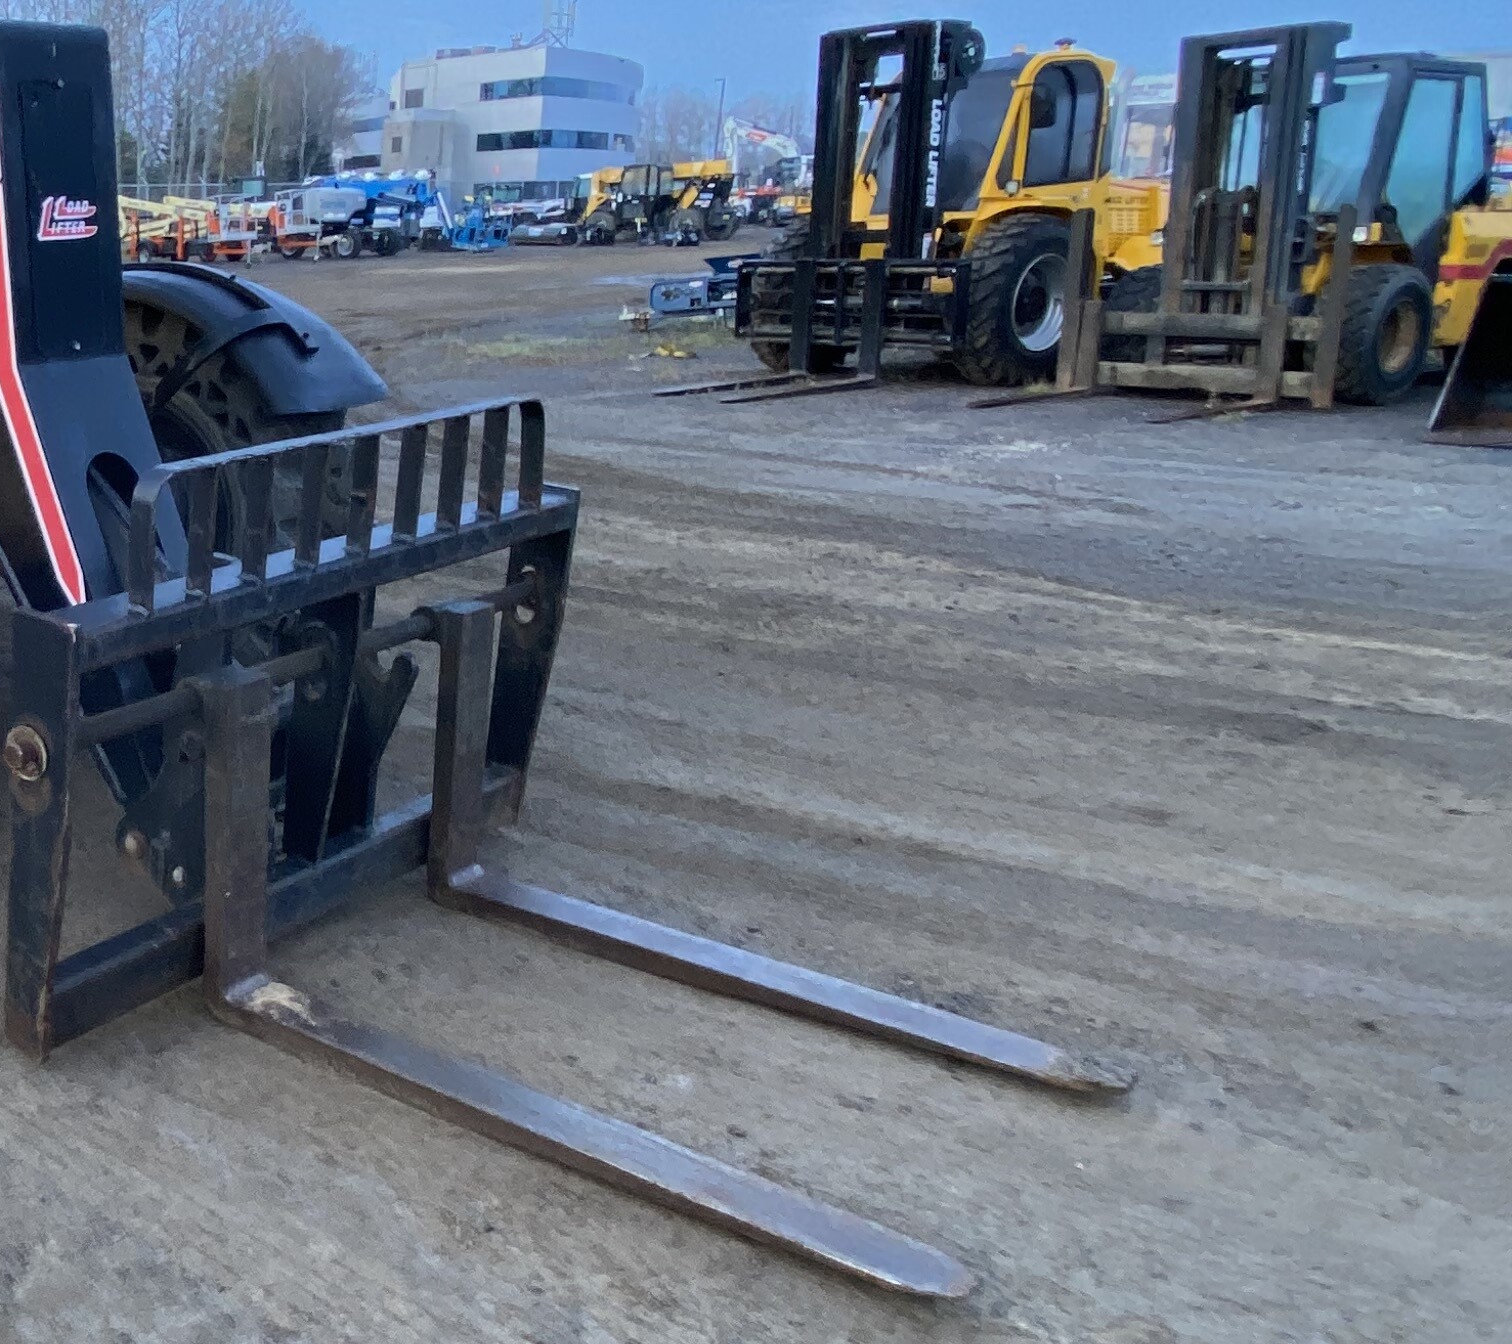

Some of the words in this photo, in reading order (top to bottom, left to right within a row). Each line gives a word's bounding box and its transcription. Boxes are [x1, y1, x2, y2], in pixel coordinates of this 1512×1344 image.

[930, 99, 943, 147] LOAD
[925, 150, 939, 208] LIFTER
[53, 195, 97, 220] LOAD
